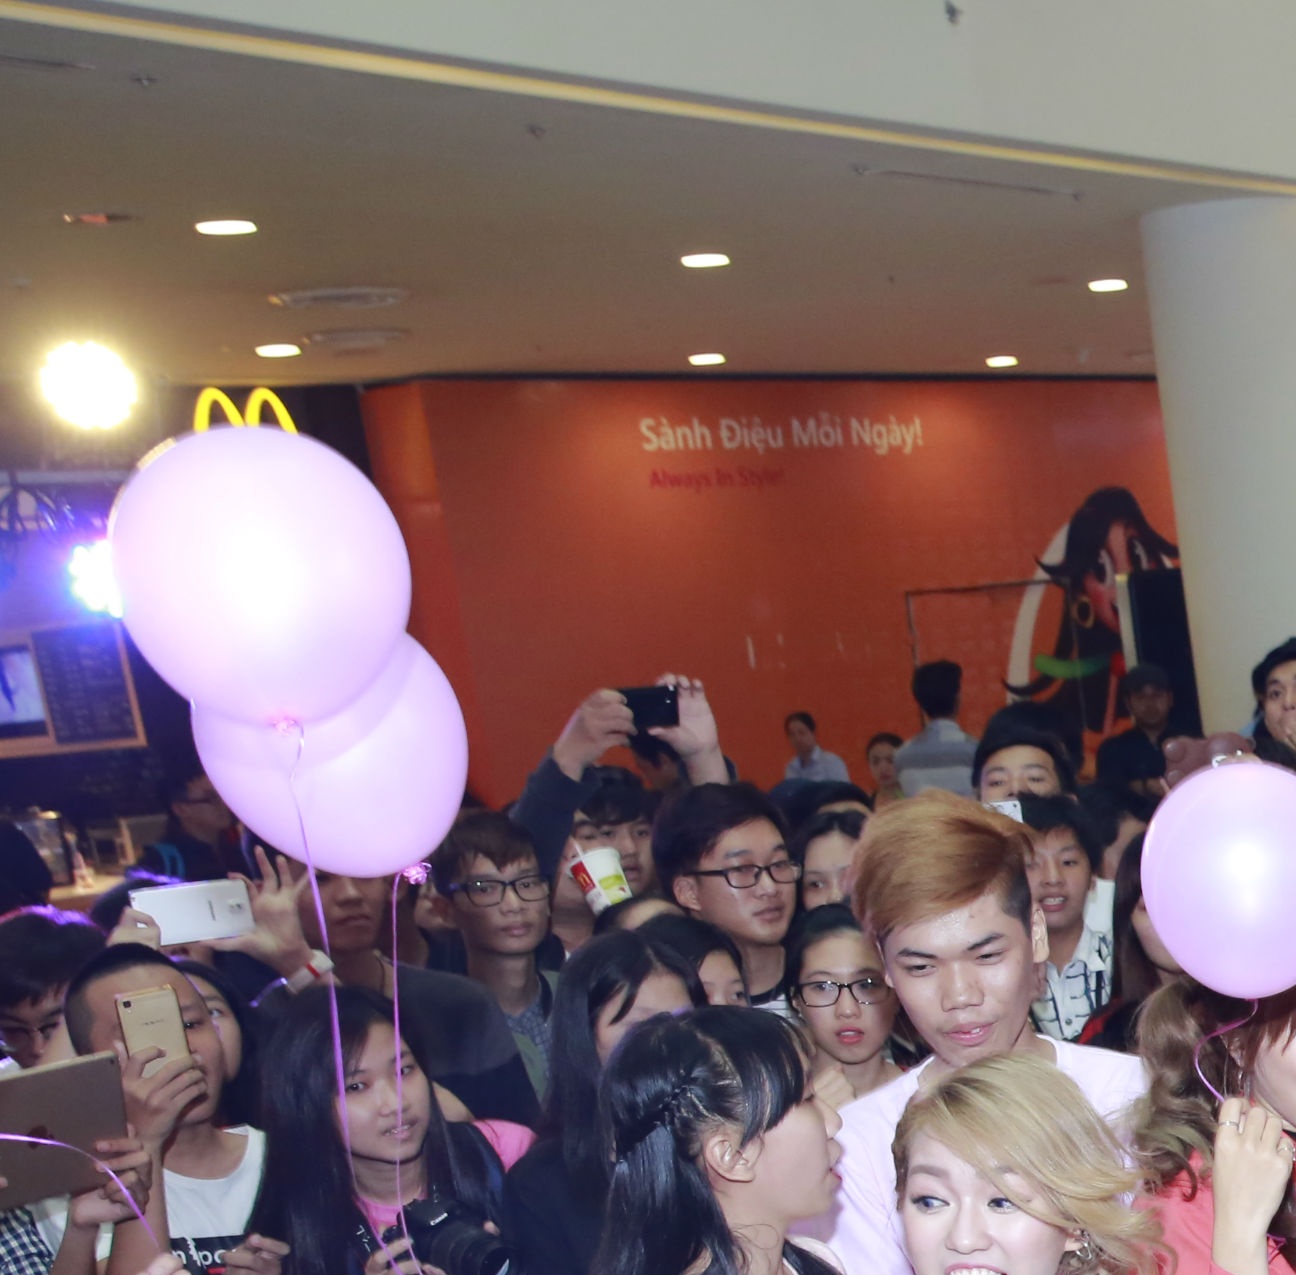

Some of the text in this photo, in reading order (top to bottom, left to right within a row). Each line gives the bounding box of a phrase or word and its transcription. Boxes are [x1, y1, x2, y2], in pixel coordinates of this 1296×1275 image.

[640, 411, 924, 455] Sành Điệu Mỗi Ngày!
